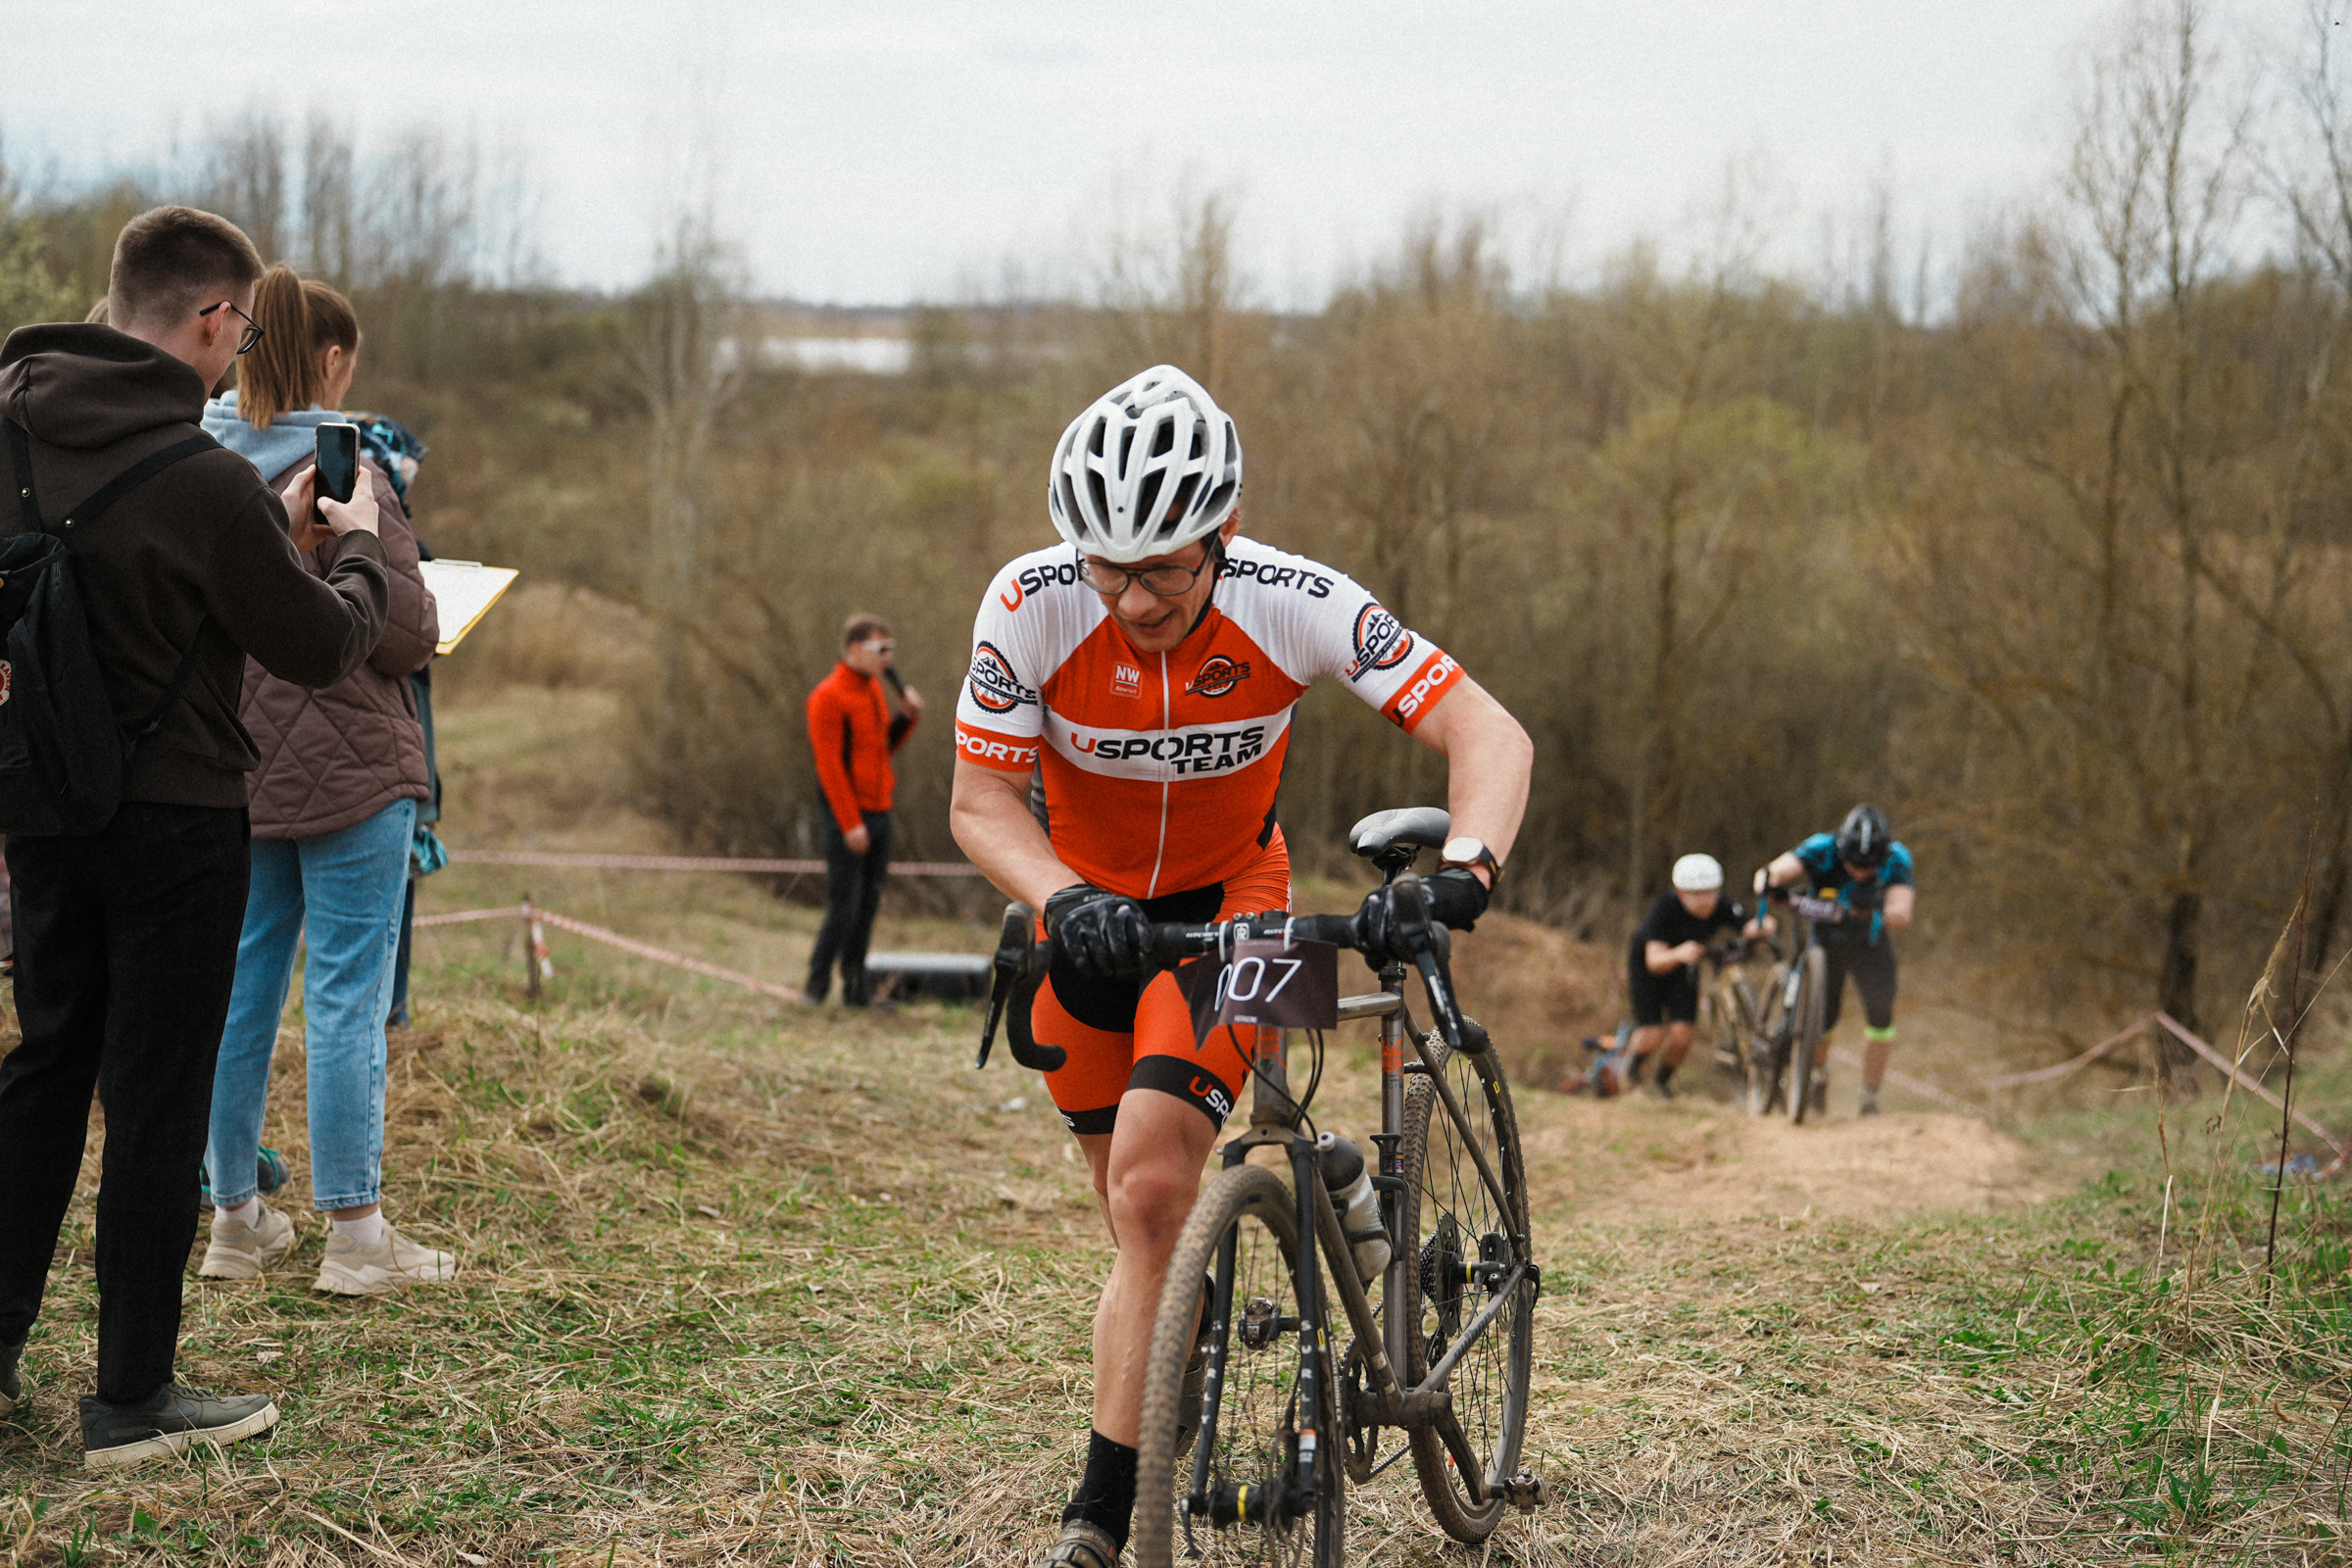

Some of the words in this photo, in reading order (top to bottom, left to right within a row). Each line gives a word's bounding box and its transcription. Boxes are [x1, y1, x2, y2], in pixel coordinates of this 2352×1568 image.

[1218, 558, 1335, 599] SPORTS
[1115, 664, 1140, 683] NW
[1071, 725, 1264, 760] USPORTS
[1170, 743, 1262, 774] TEAM
